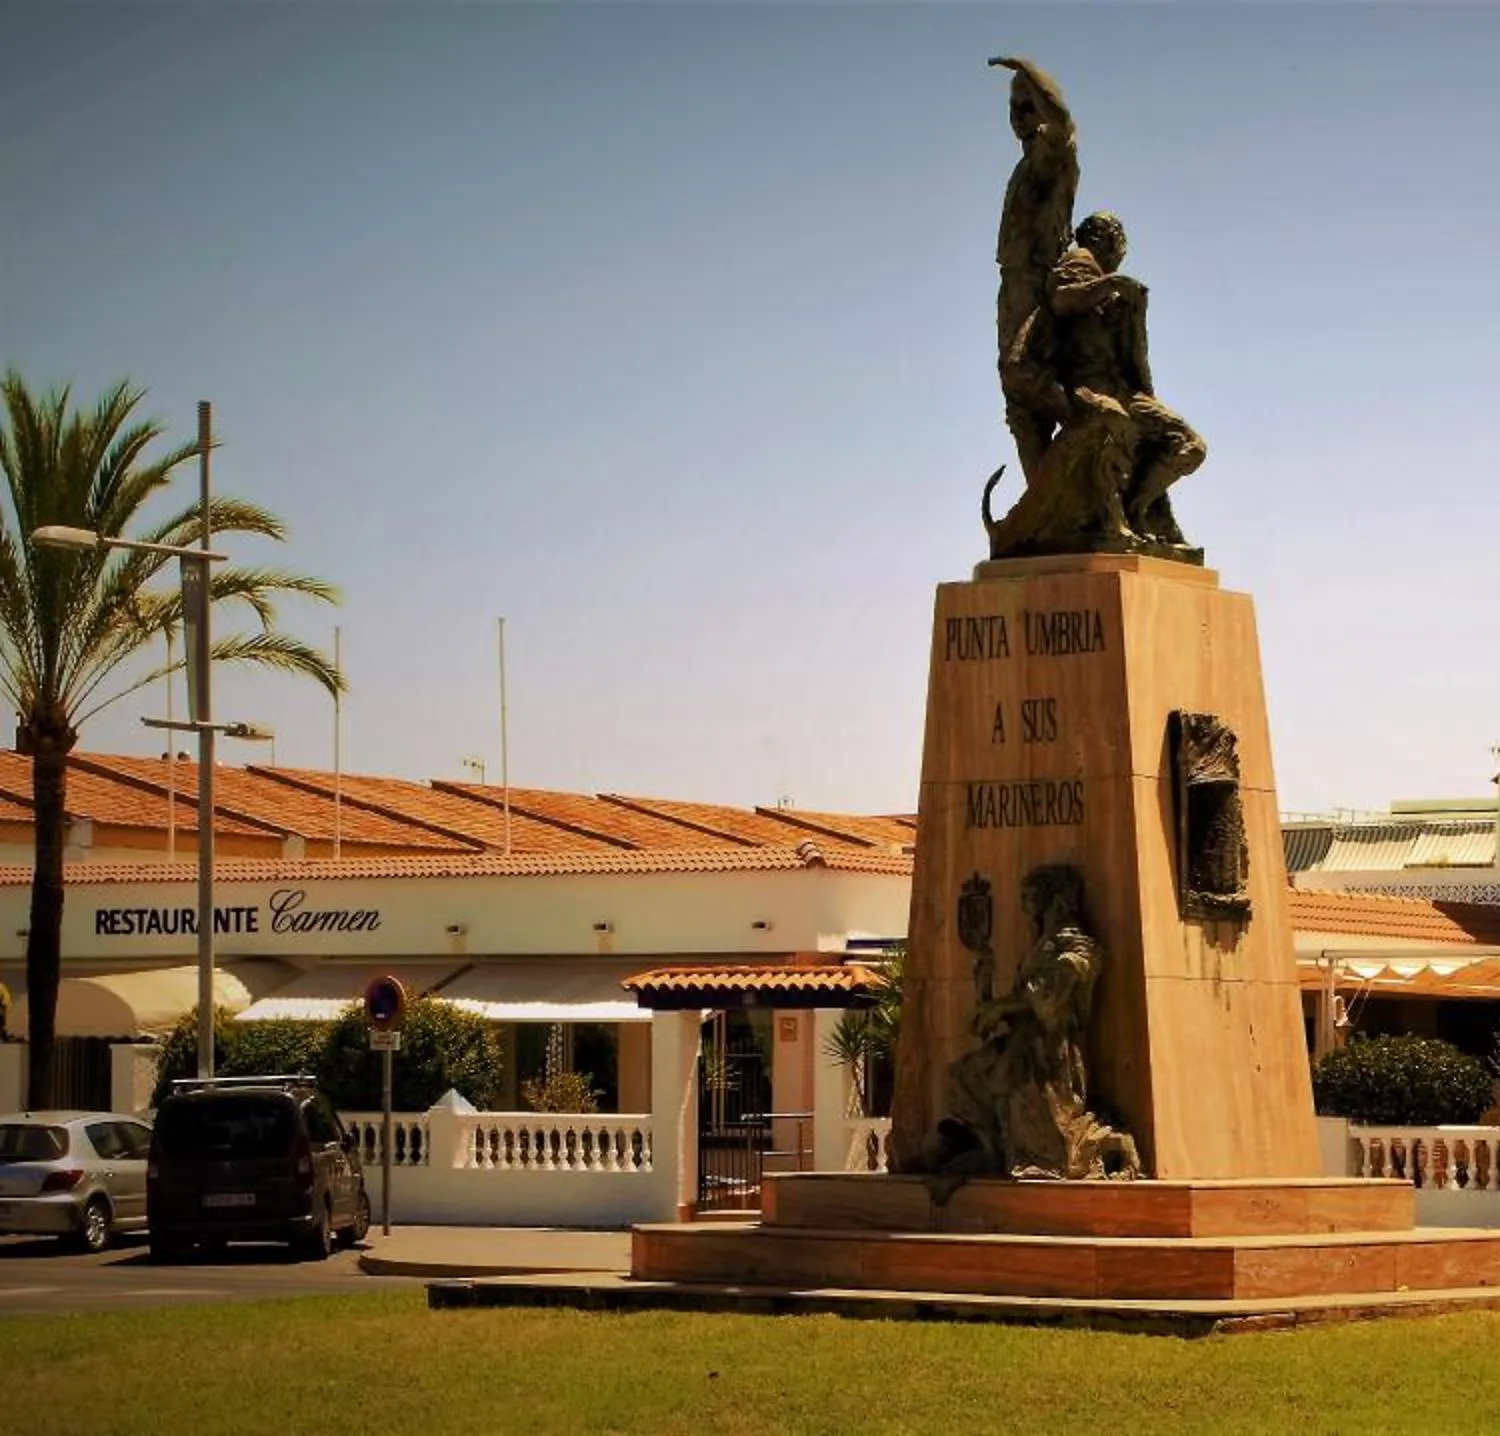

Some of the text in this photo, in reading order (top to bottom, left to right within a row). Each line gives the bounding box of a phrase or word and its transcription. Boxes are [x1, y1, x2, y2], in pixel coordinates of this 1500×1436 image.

[947, 609, 1106, 661] PUNTA UMBRIA
[991, 698, 1059, 743] A SUS
[967, 781, 1084, 828] MARINEROS
[96, 888, 382, 935] RESTAURNTE Carmen
